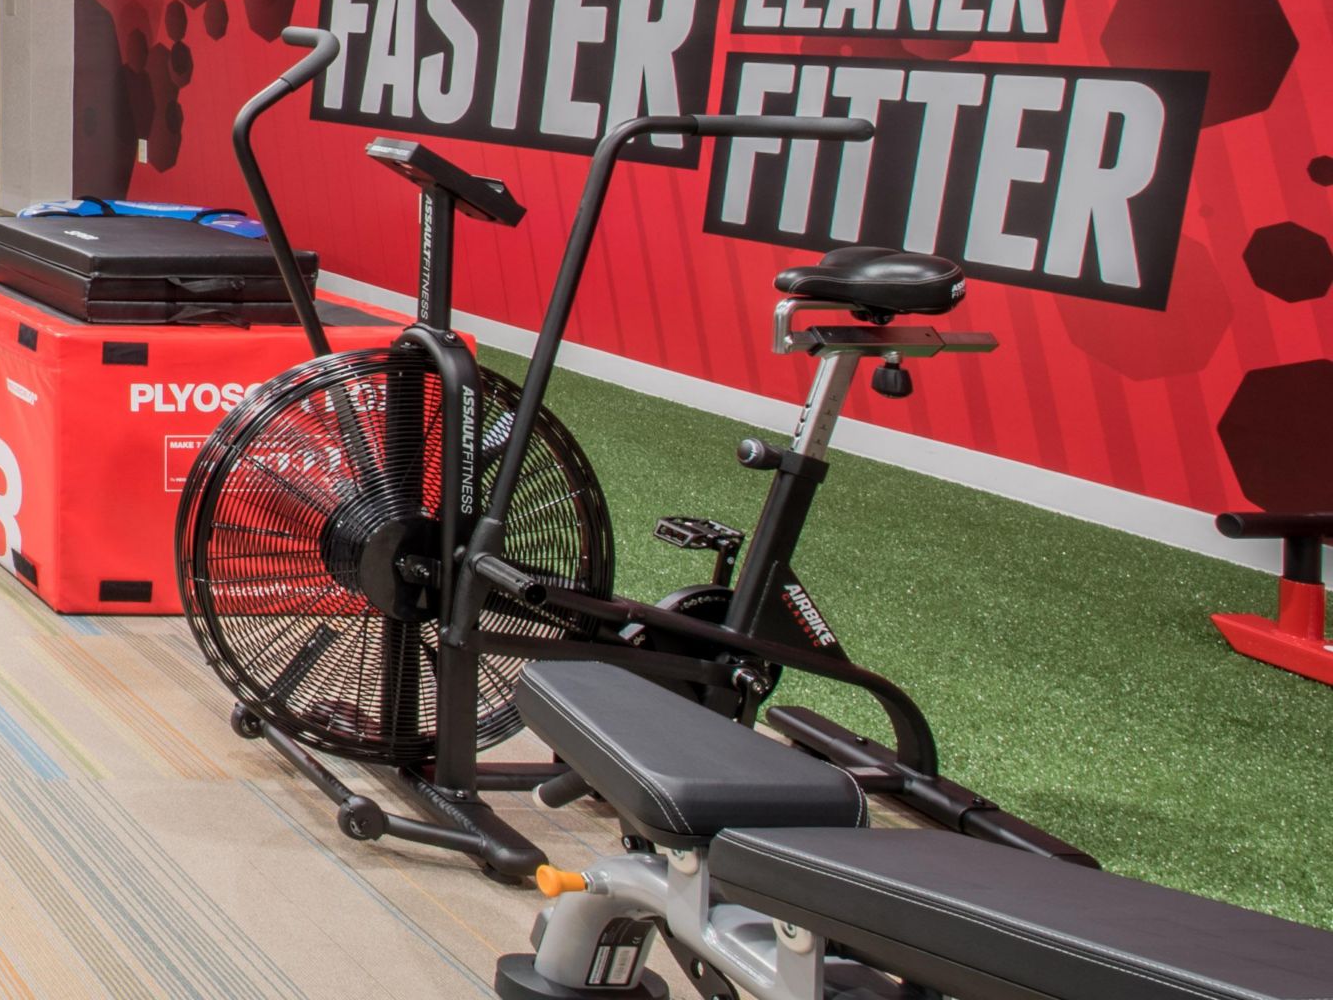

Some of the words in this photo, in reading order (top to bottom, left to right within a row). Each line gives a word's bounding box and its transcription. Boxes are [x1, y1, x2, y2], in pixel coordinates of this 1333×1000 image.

[722, 59, 1165, 289] FITTER
[421, 194, 434, 320] ASSAULTFITNESS
[169, 441, 194, 449] MAKE
[460, 384, 475, 515] ASSAULTFITNESS
[782, 584, 837, 646] AIRBIKE
